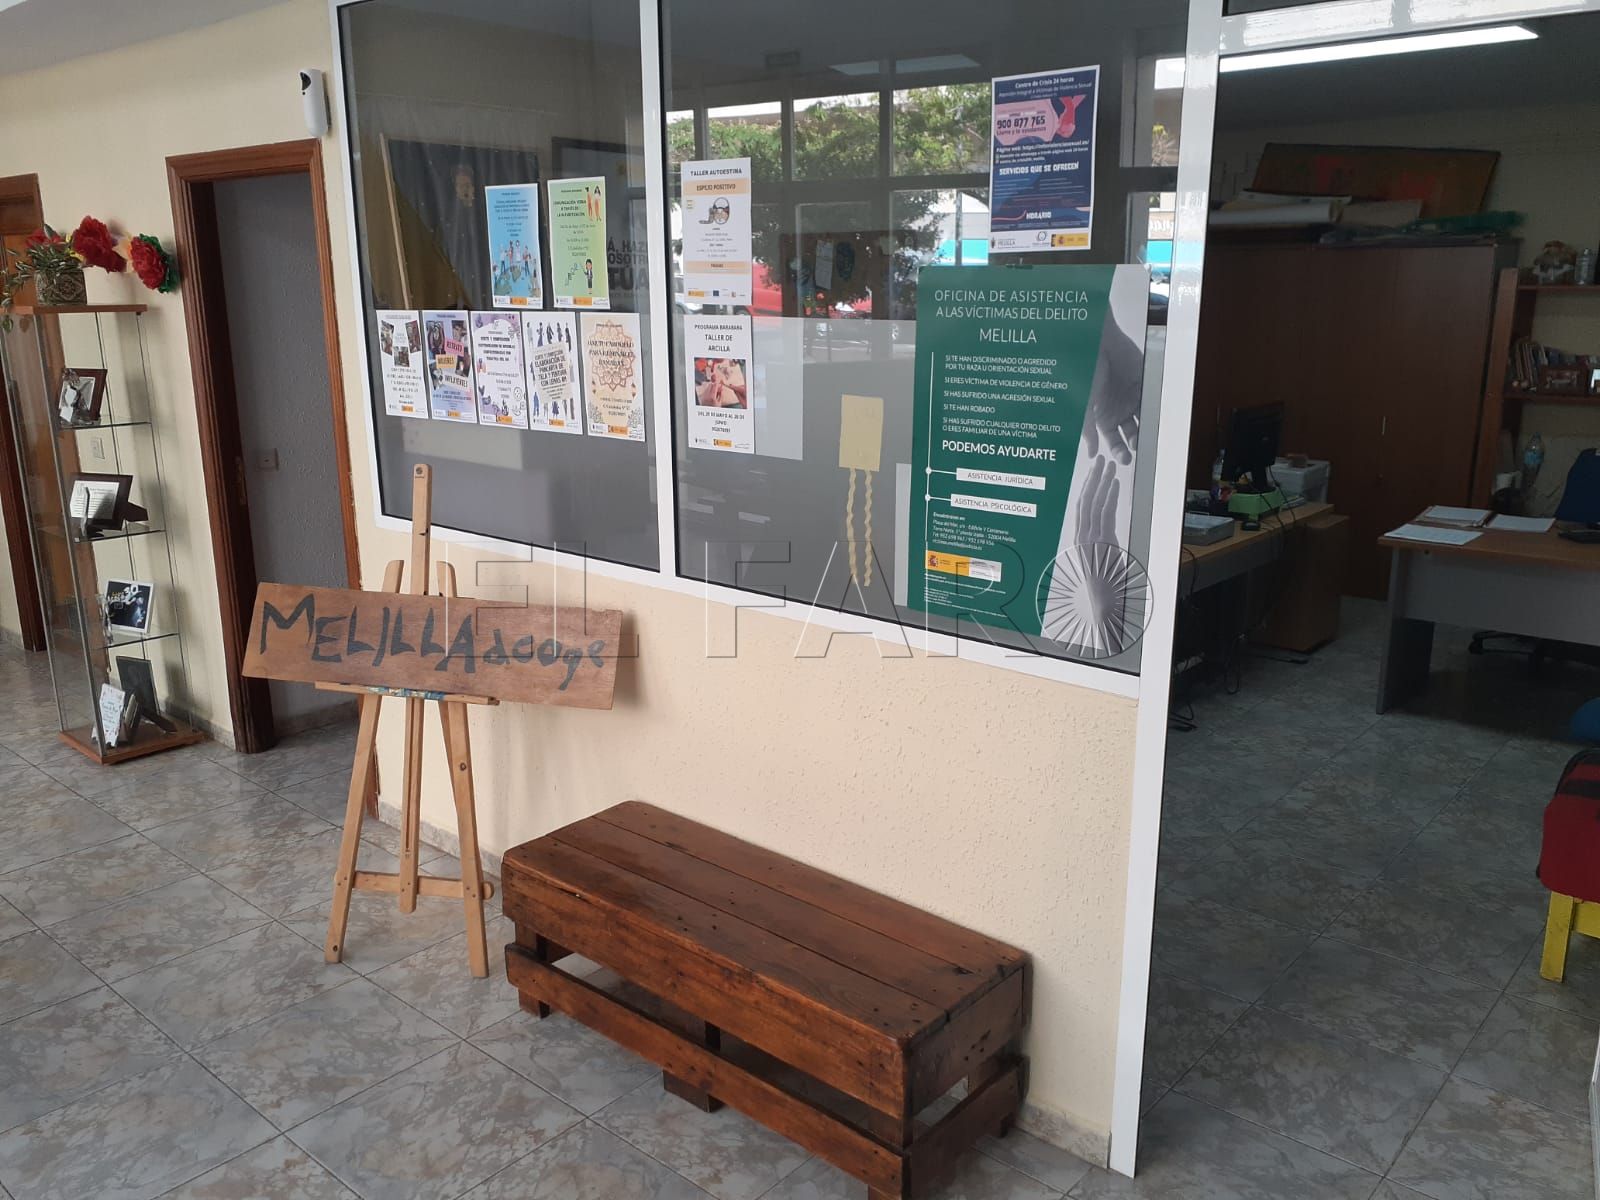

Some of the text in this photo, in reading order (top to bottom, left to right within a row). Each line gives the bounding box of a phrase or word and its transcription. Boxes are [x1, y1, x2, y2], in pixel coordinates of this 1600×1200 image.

[996, 115, 1046, 129] 900 877 765
[690, 169, 709, 177] TALLER
[999, 166, 1029, 176] SERVICIOS
[1030, 164, 1044, 174] QUE
[1044, 164, 1052, 173] SE
[934, 290, 1088, 303] OFICINA DE ASISTENCIA
[936, 304, 1088, 321] A LAS VÍCTIMAS DEL DELITO
[705, 334, 733, 342] TALLER DE
[979, 328, 1037, 344] MELILLA
[708, 345, 731, 353] ARCILLA
[972, 356, 1017, 365] DISCRIMINADO
[1023, 358, 1057, 366] AGREDIDO
[988, 365, 1029, 374] ORIENTACIÓN
[1029, 367, 1052, 375] SEXUAL
[964, 377, 990, 386] VÍCTIMA
[999, 380, 1030, 388] VIOLENCIA
[1041, 381, 1068, 390] GÉNERO
[1001, 393, 1032, 402] AGRESIÓN
[1032, 395, 1056, 403] SEXUAL
[956, 404, 970, 412] HAN
[970, 405, 995, 414] ROBADO
[960, 418, 985, 426] SUFRIDO
[985, 420, 1020, 430] CUALQUIER
[1020, 422, 1038, 431] OTRO
[1038, 424, 1061, 432] DELITO
[962, 427, 988, 435] FAMILIAR
[1011, 430, 1037, 439] VÍCTIMA
[942, 439, 1057, 461] PODEMOS AYUDARTE
[967, 472, 1033, 485] ASISTENCIA JURÍDICA
[954, 498, 1032, 513] ASISTENCIA PSICOLÓGICA
[259, 593, 477, 674] MELILLA
